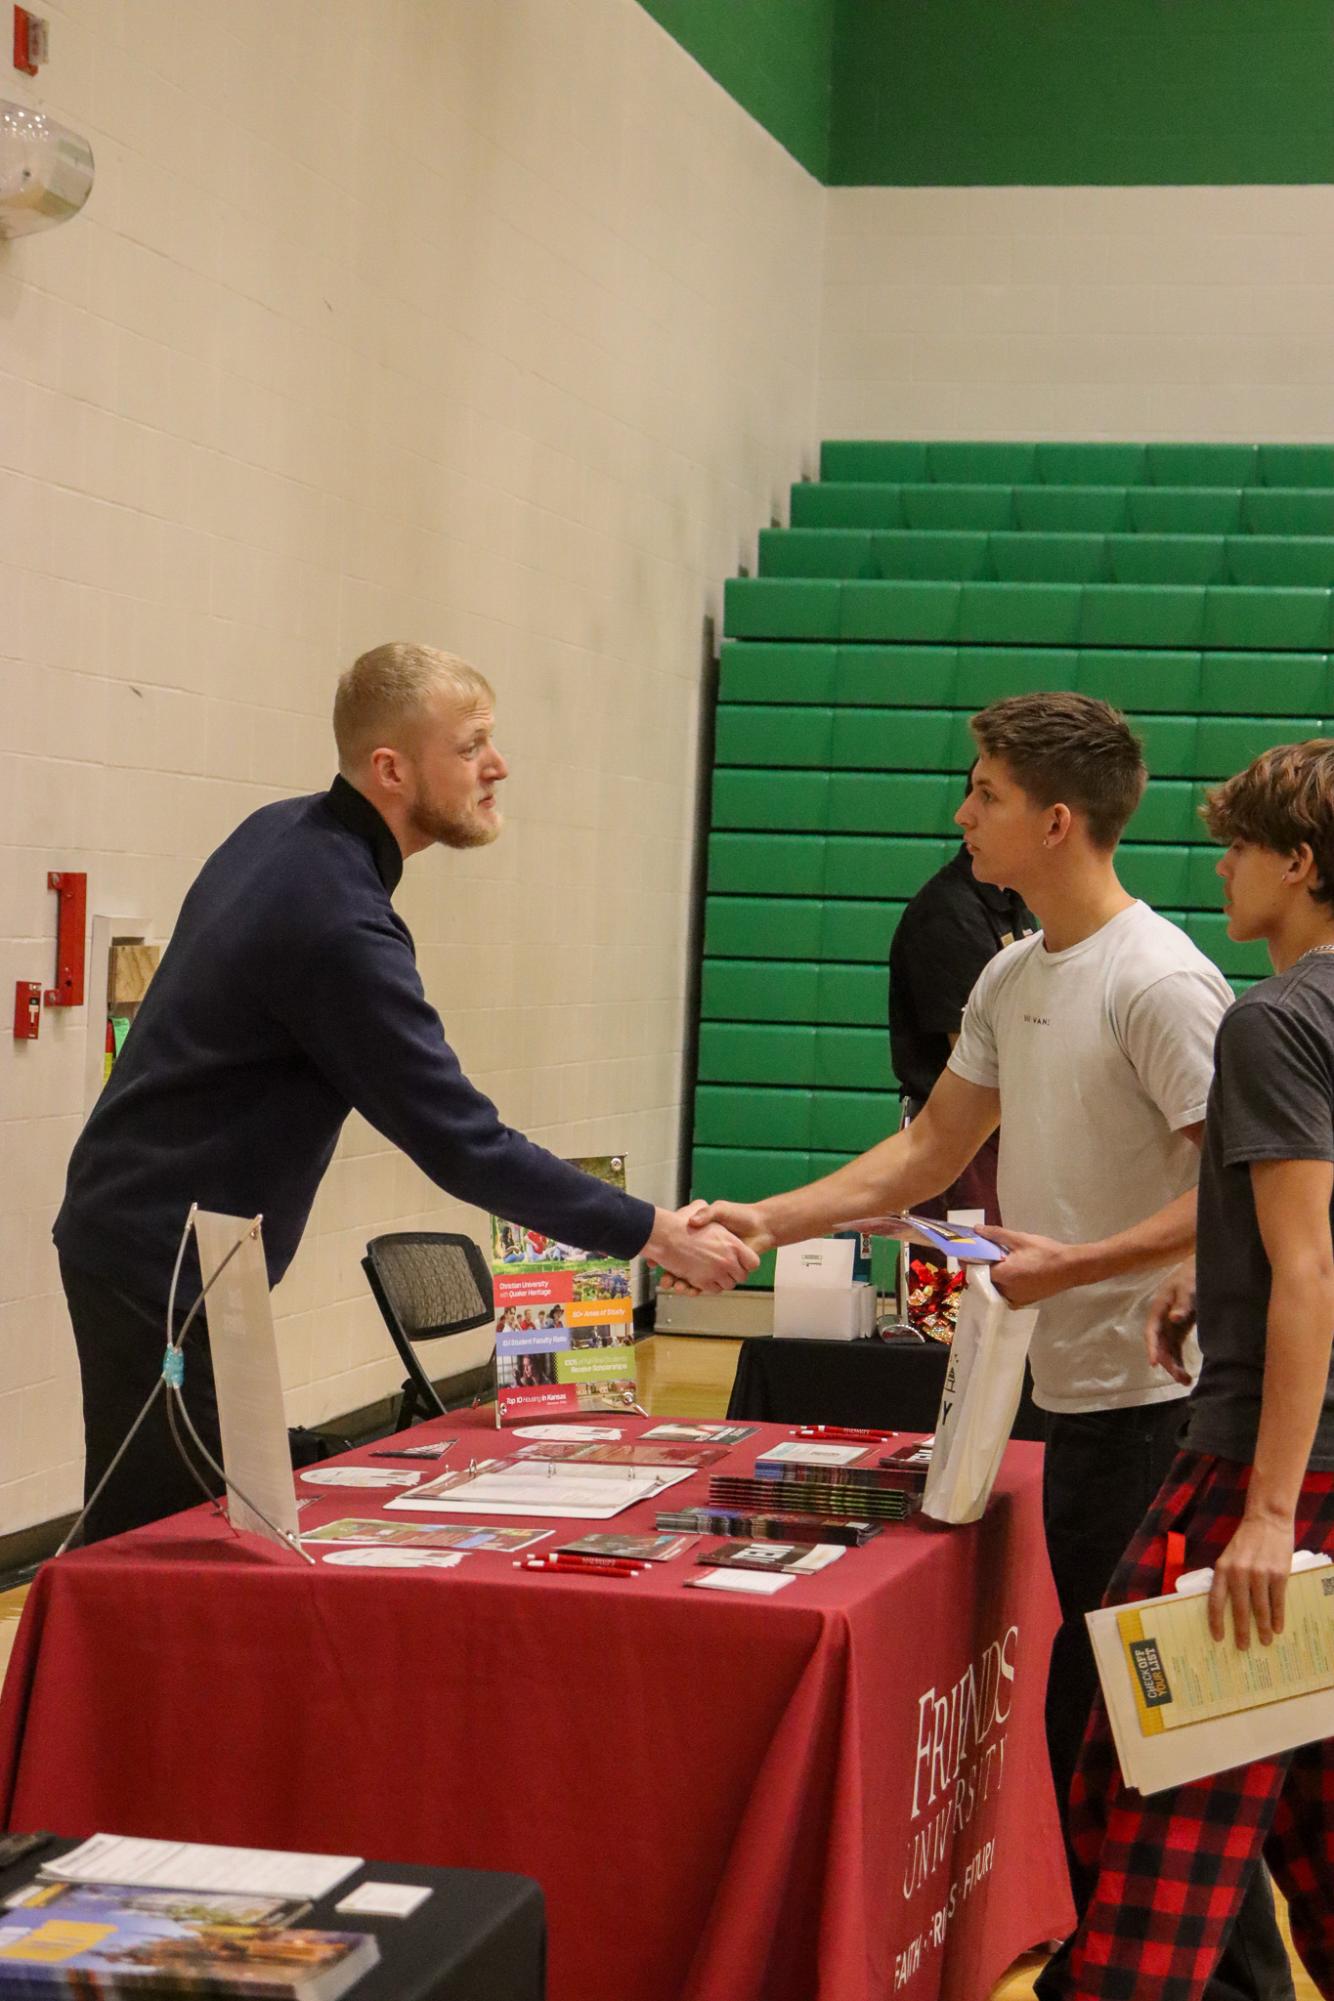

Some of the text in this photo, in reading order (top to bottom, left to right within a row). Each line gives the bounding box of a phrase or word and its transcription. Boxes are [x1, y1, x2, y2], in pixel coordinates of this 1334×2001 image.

[506, 1396, 516, 1405] Top
[516, 1395, 523, 1403] 10
[547, 1392, 567, 1401] Kansas
[1135, 1649, 1158, 1698] CHECK OFF
[1144, 1647, 1168, 1697] YOUR LIST
